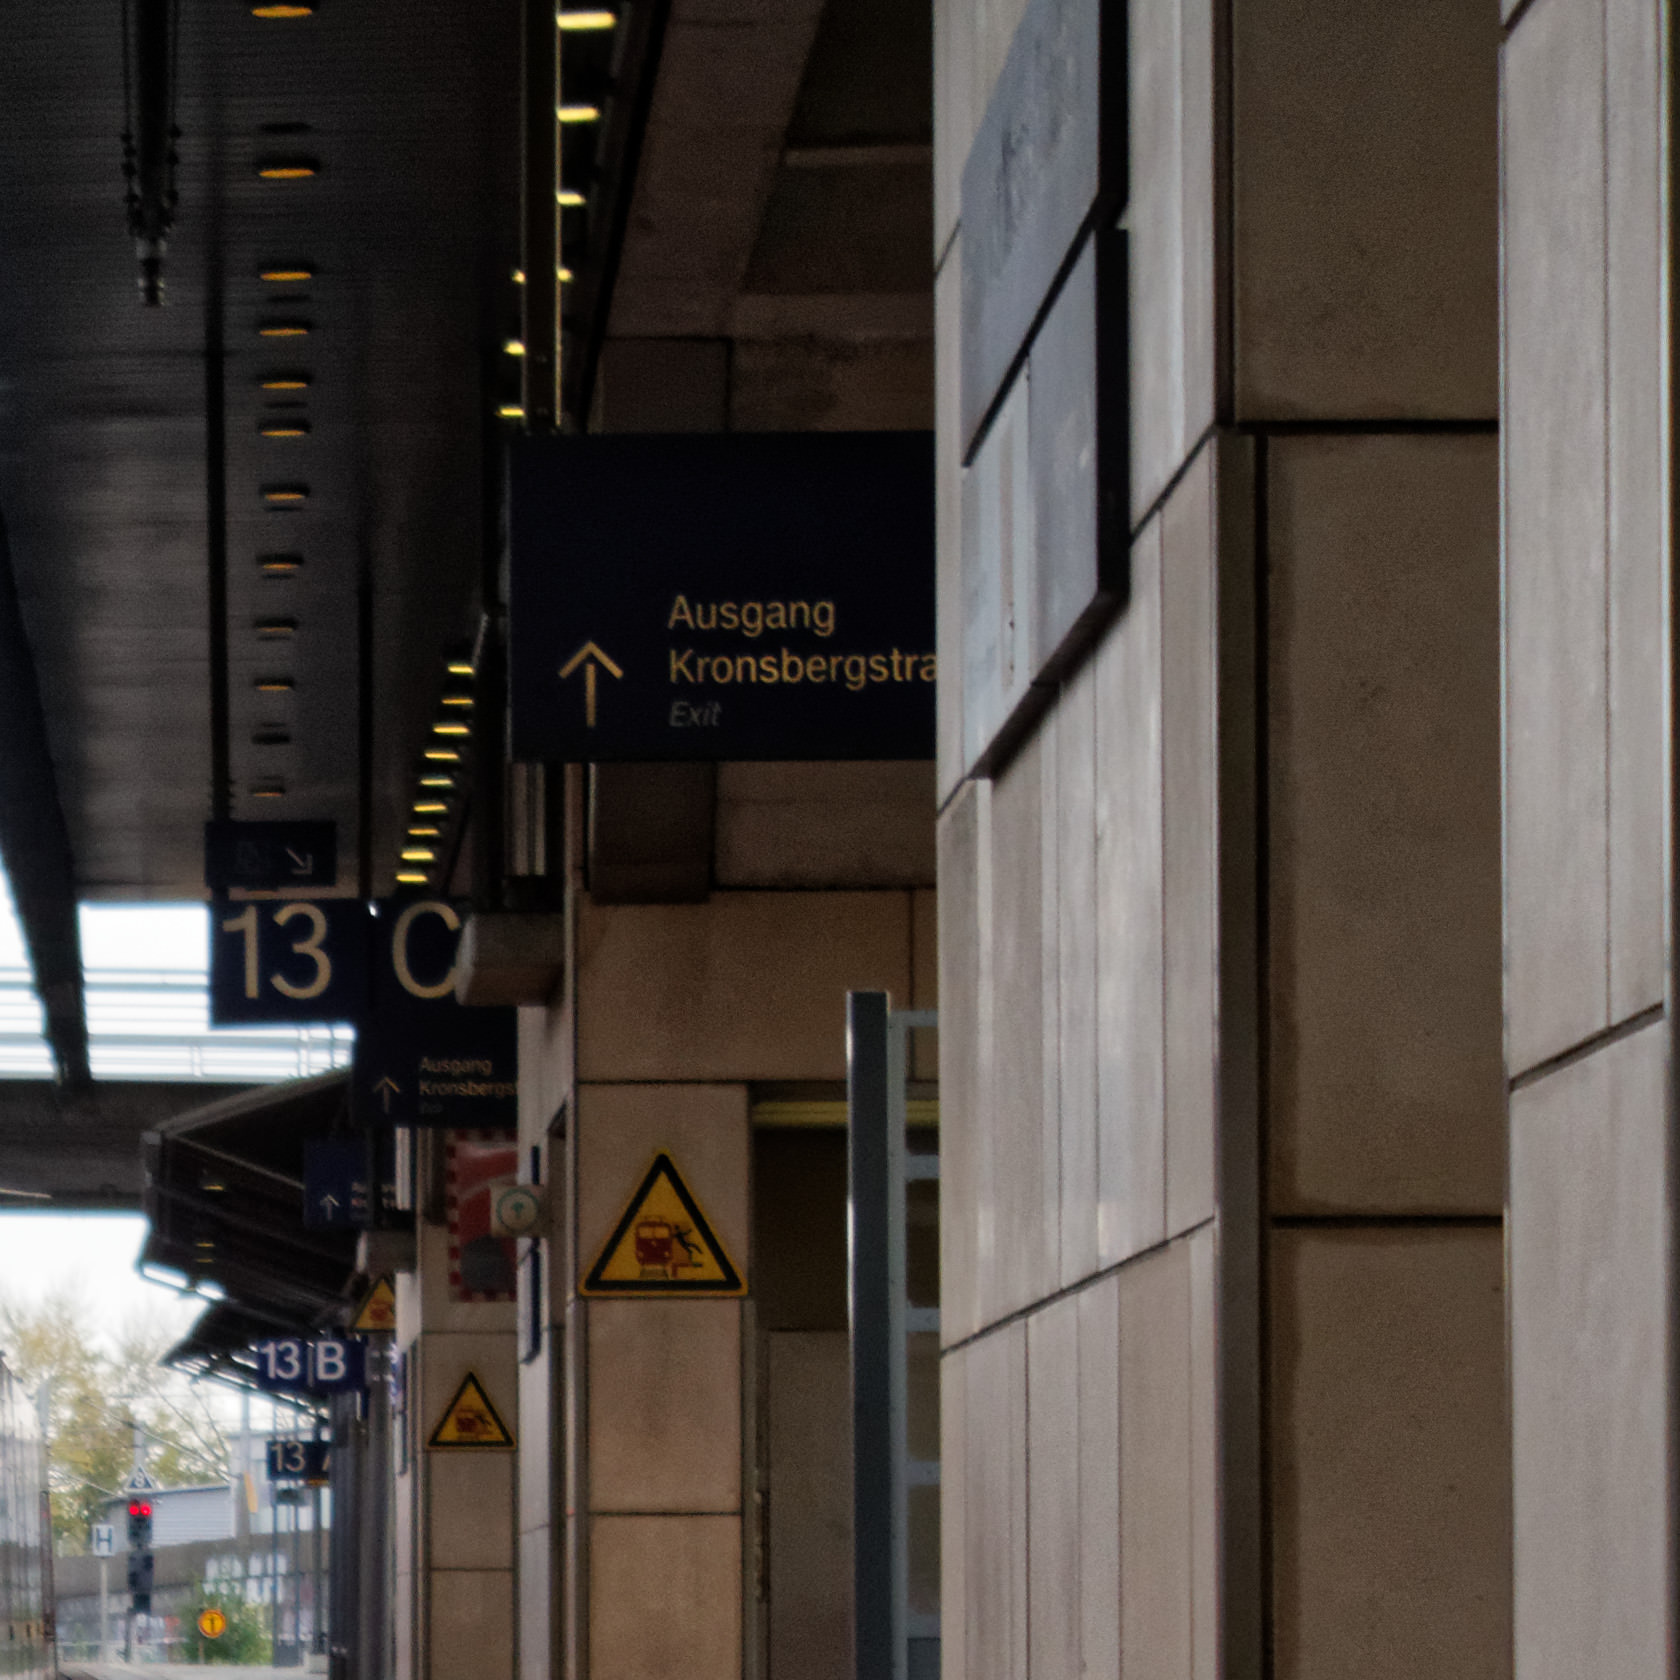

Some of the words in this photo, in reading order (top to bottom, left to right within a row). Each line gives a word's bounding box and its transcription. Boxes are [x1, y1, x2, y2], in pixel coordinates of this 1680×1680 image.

[667, 594, 836, 638] Ausgang
[669, 646, 937, 691] Kronsbergstra
[669, 700, 723, 728] Exit
[222, 901, 332, 999] 13
[392, 901, 461, 999] C
[259, 1341, 301, 1380] 13
[316, 1341, 346, 1380] B
[271, 1441, 306, 1473] 13
[96, 1527, 113, 1553] H
